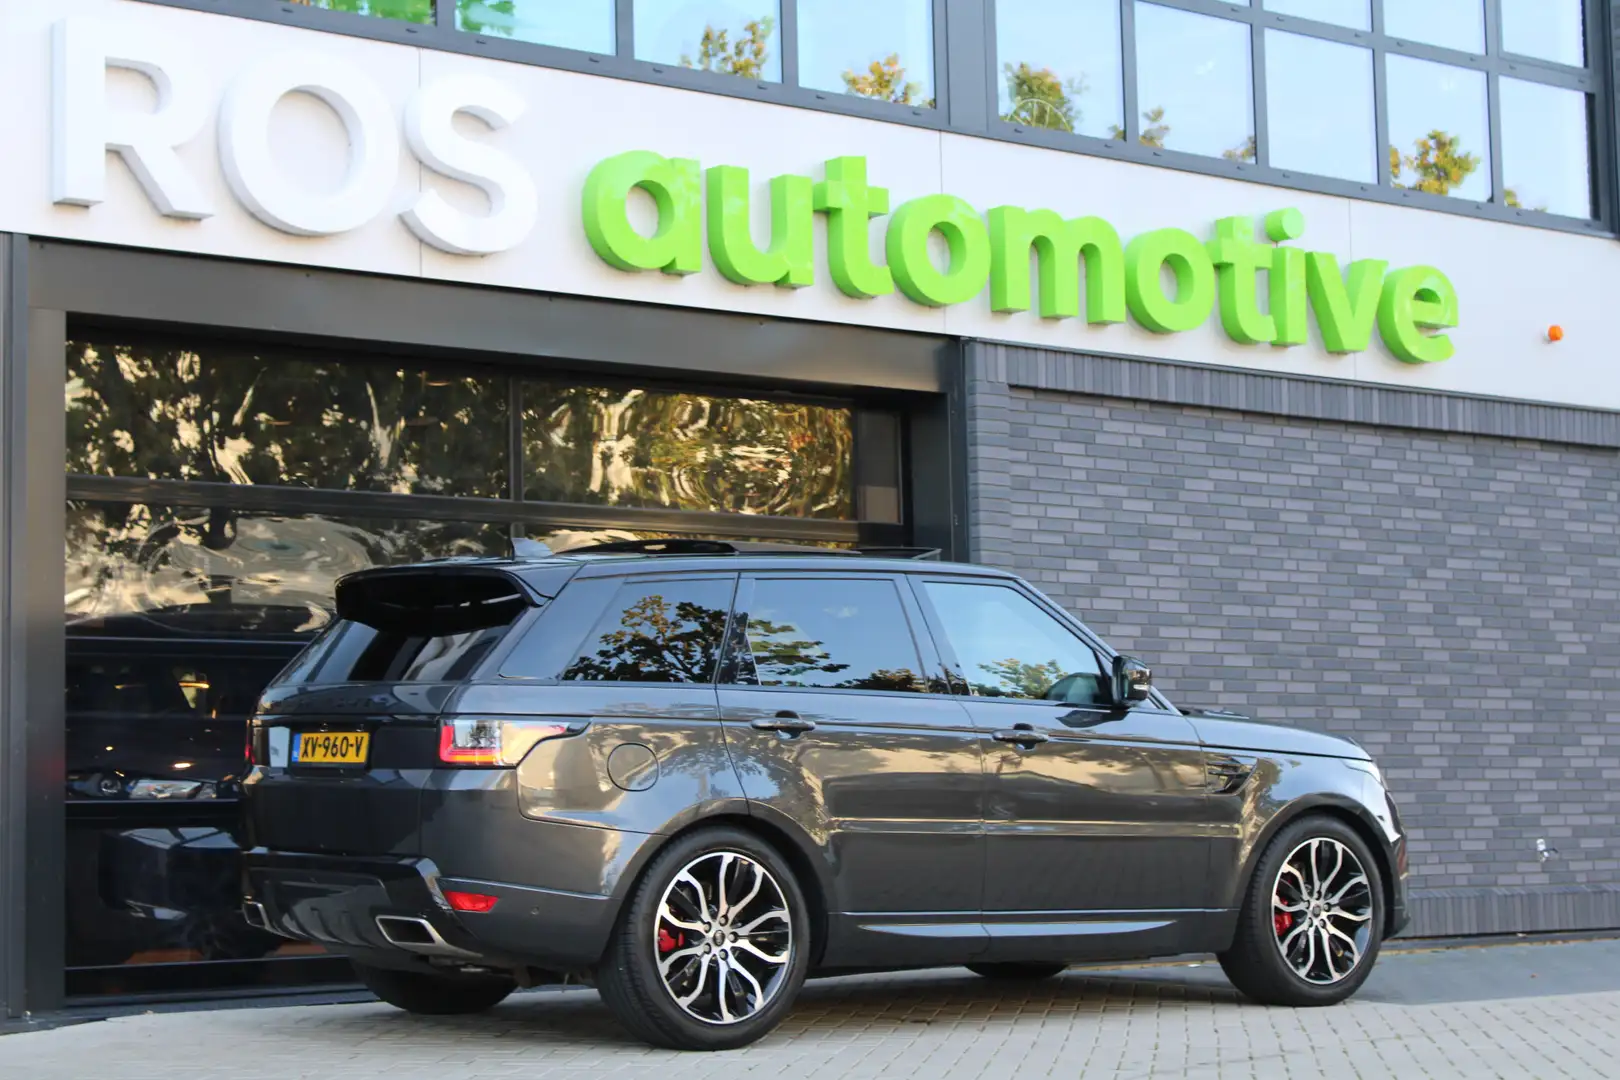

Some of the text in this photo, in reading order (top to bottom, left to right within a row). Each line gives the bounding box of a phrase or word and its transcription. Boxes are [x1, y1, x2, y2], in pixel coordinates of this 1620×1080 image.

[51, 15, 1458, 364] ROS automotive
[301, 735, 365, 758] XV-960-V
